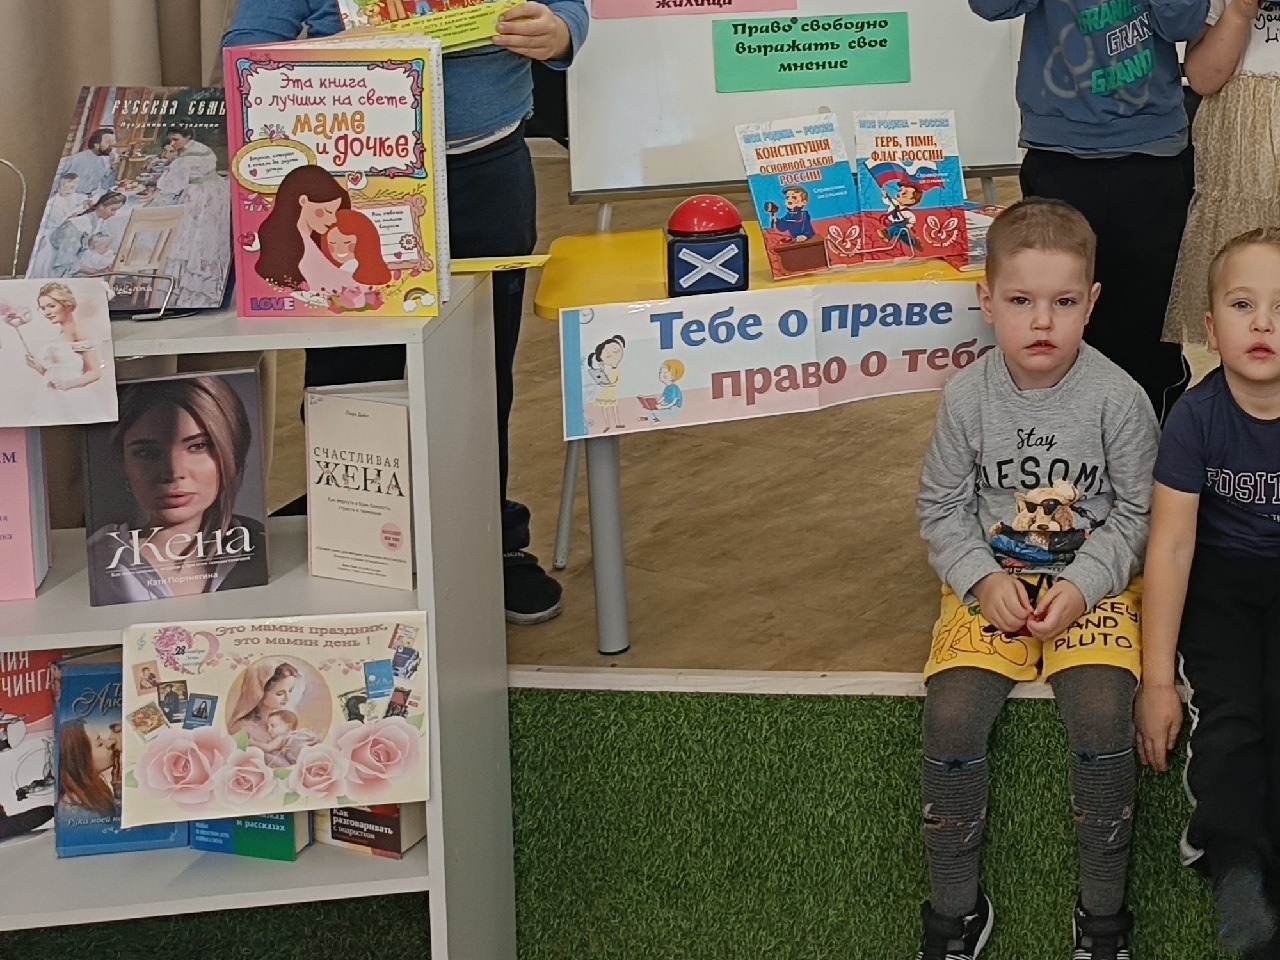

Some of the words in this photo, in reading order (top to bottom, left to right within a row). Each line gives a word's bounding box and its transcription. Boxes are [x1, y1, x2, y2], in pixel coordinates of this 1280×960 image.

[732, 21, 792, 37] Право
[800, 16, 889, 35] свободно
[1106, 12, 1154, 56] GRAN
[735, 37, 841, 56] выражать
[848, 36, 888, 50] свое
[778, 58, 848, 73] мнение
[1091, 49, 1154, 94] GRAND
[280, 73, 314, 89] Эта
[319, 77, 367, 89] книга
[111, 100, 179, 115] РУССКАЯ
[188, 100, 226, 115] СЕМЬ
[255, 96, 263, 106] о
[269, 93, 327, 112] лучших
[332, 92, 352, 107] на
[358, 89, 408, 108] свете
[292, 111, 365, 140] маме
[316, 141, 330, 155] и
[333, 134, 409, 167] дочке
[755, 139, 830, 160] КОНСТИТУЦИЯ
[875, 136, 902, 148] ГЕРБ,
[906, 136, 937, 148] ГИМН,
[871, 151, 897, 161] ФЛАГ
[901, 150, 943, 160] РОССИИ
[760, 159, 806, 174] ОСНОВНОЙ
[807, 156, 834, 168] ЗАКОН
[780, 171, 821, 184] РОССИИ
[250, 296, 295, 311] LOVE
[650, 307, 762, 350] Тебе
[778, 309, 807, 338] о
[821, 301, 952, 337] праве
[711, 355, 847, 406] право
[860, 350, 887, 376] о
[1017, 427, 1057, 451] Stay
[314, 447, 399, 468] СЧАСТЛИВАЯ
[314, 460, 405, 497] ЖЕНА
[106, 526, 255, 570] Жена
[147, 577, 167, 586] Катя
[168, 572, 218, 584] Портнягина
[216, 625, 245, 636] Это
[250, 624, 303, 634] мамин
[309, 623, 388, 636] праздник,
[1067, 616, 1118, 634] AND
[233, 638, 262, 647] это
[267, 638, 319, 647] мамин
[324, 640, 361, 649] день
[1054, 633, 1132, 652] PLUTO
[333, 808, 348, 817] Как
[244, 821, 285, 831] рассказах
[333, 817, 393, 834] разговаривать
[339, 827, 375, 839] подростком
